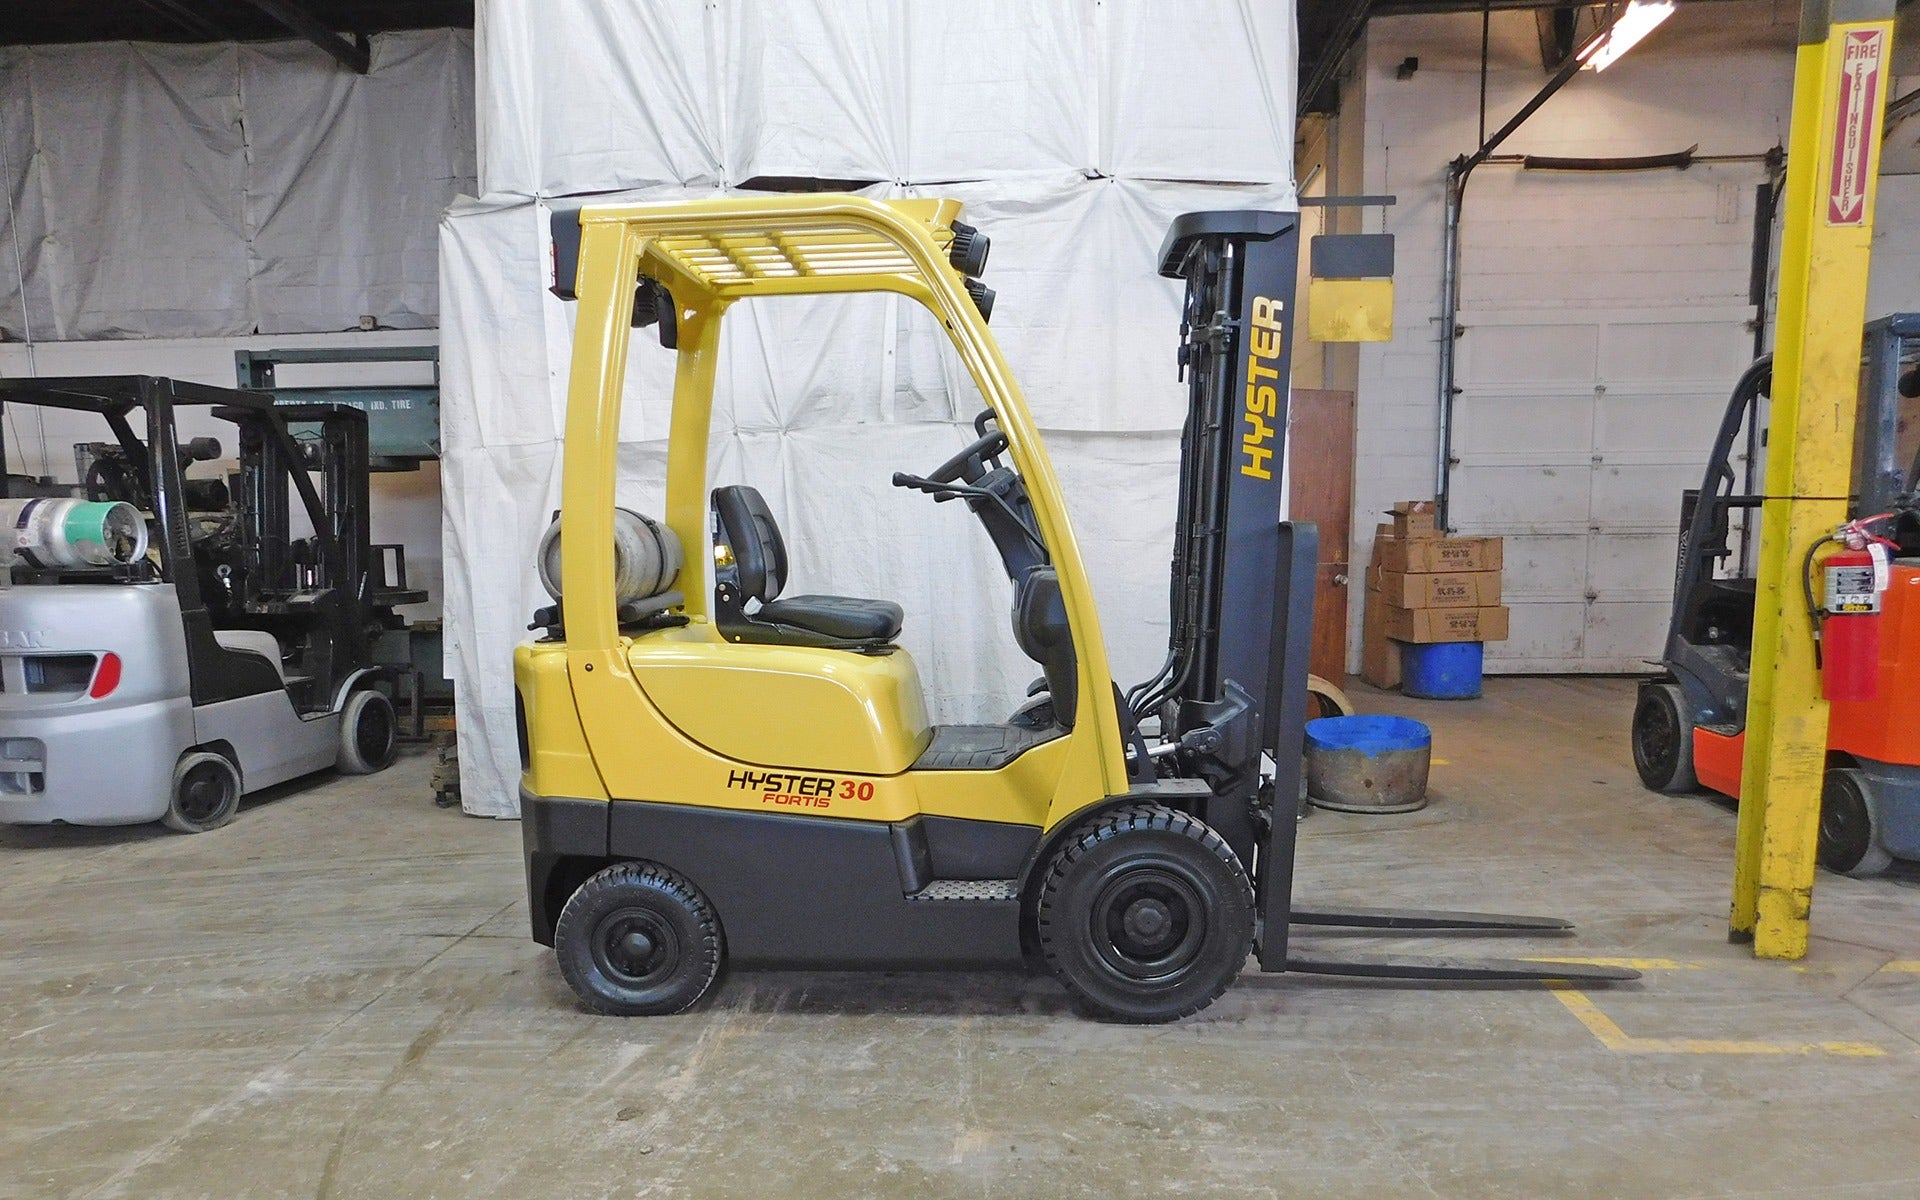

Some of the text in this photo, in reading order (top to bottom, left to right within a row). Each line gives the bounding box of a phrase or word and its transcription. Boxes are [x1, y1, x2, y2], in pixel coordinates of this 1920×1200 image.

[1847, 43, 1877, 61] FIRE
[1841, 62, 1862, 212] EXTINGUISHER
[1241, 296, 1284, 481] HYSTER
[391, 399, 412, 410] TIRE
[727, 769, 875, 801] HYSTER 30
[762, 793, 831, 808] FORTIS
